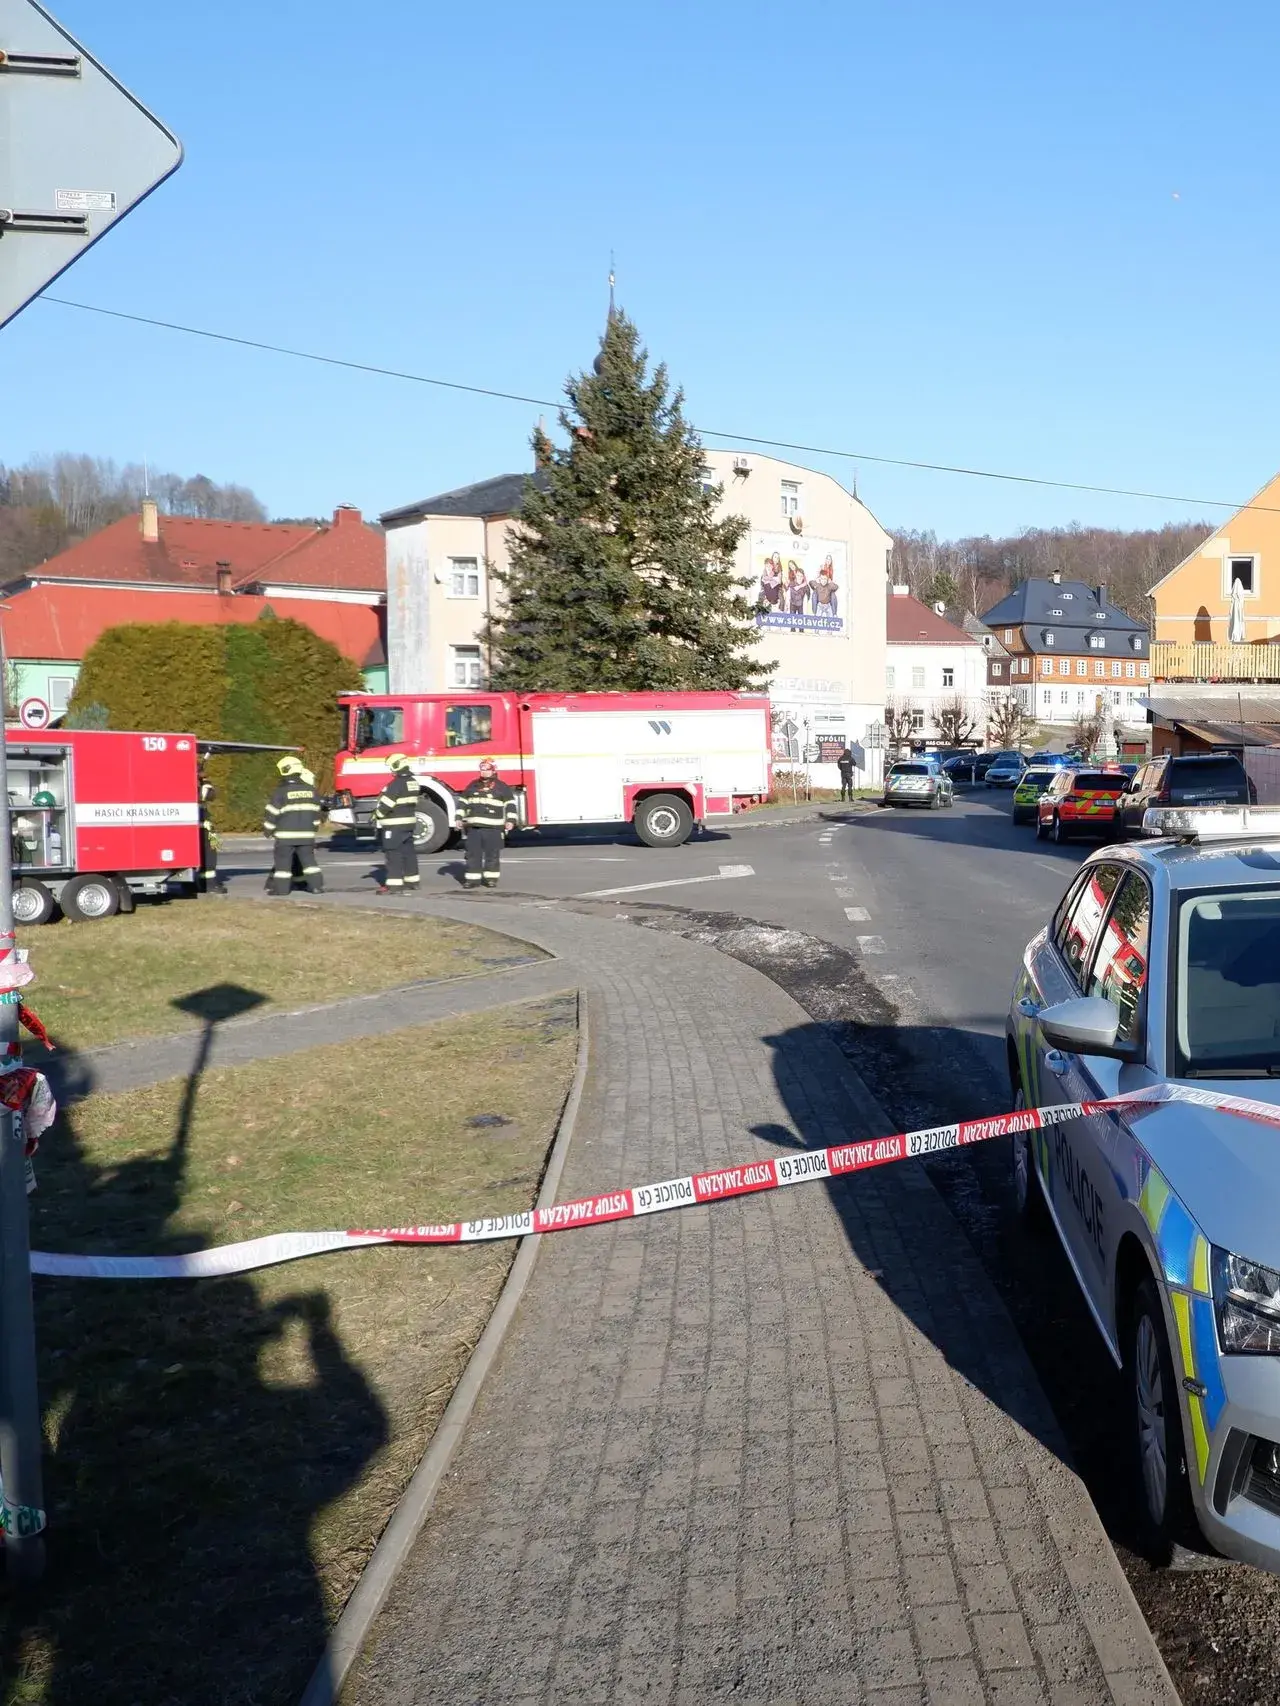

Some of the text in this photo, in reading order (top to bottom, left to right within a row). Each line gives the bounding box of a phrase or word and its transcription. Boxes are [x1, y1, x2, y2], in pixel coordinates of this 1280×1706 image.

[760, 615, 841, 628] www.skolavdf.cz
[142, 737, 167, 751] 150
[94, 807, 123, 818] HASIČI
[925, 1128, 957, 1151] POLICIE
[780, 1153, 827, 1180] POLICIE ČR
[831, 1138, 902, 1170] VSTUP ZAKÁZÁN
[697, 1164, 772, 1196] VSTUP ZAKÁZÁN
[638, 1180, 692, 1209] POLICIE ČR
[539, 1194, 629, 1227] VSTUP ZAKÁZÁN
[469, 1213, 531, 1236] POLICIE ČR
